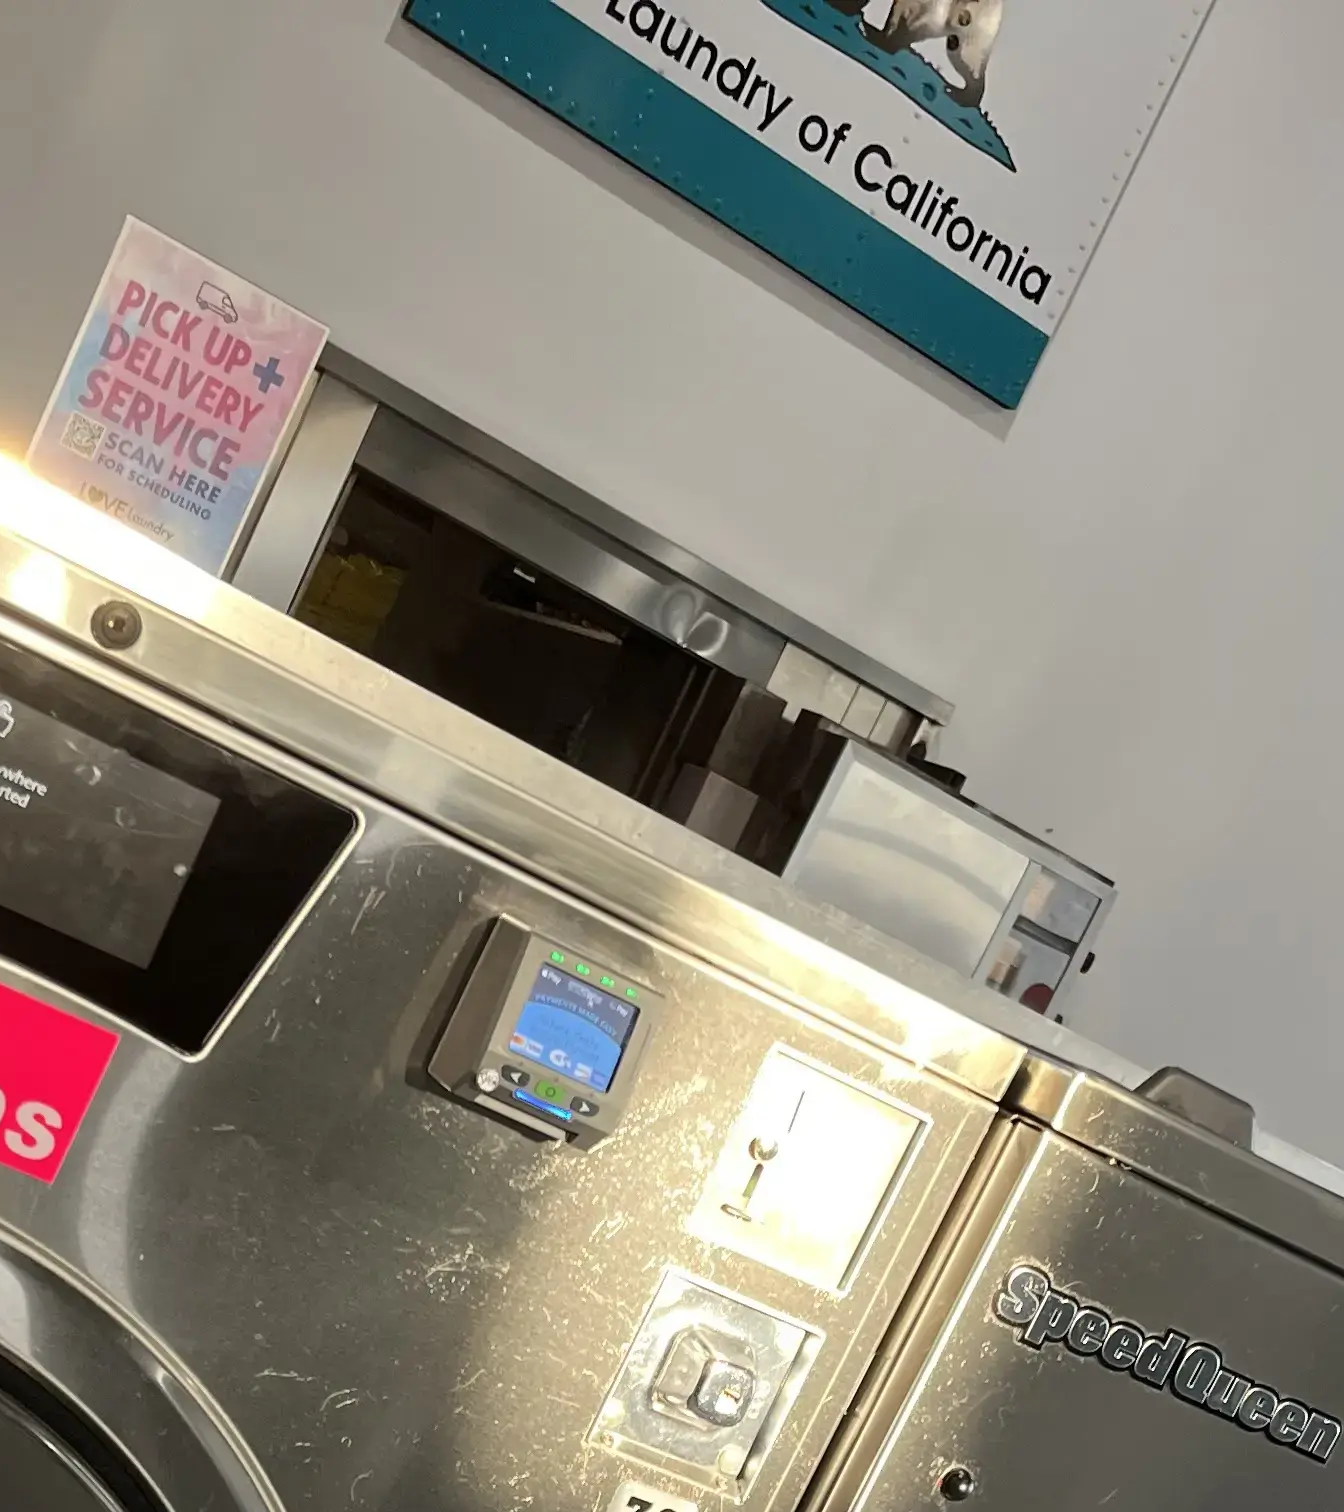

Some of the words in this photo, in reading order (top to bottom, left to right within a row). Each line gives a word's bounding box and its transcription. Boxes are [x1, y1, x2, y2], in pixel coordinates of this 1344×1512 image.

[798, 113, 851, 164] of
[855, 143, 1053, 305] California
[99, 323, 264, 433] DELIVERY
[116, 280, 203, 352] PICK
[203, 325, 252, 374] UP
[78, 369, 242, 481] SERVICE
[104, 431, 165, 475] SCAN
[168, 465, 222, 504] HERE
[97, 453, 125, 476] FOR
[127, 469, 212, 520] SCHEDULING
